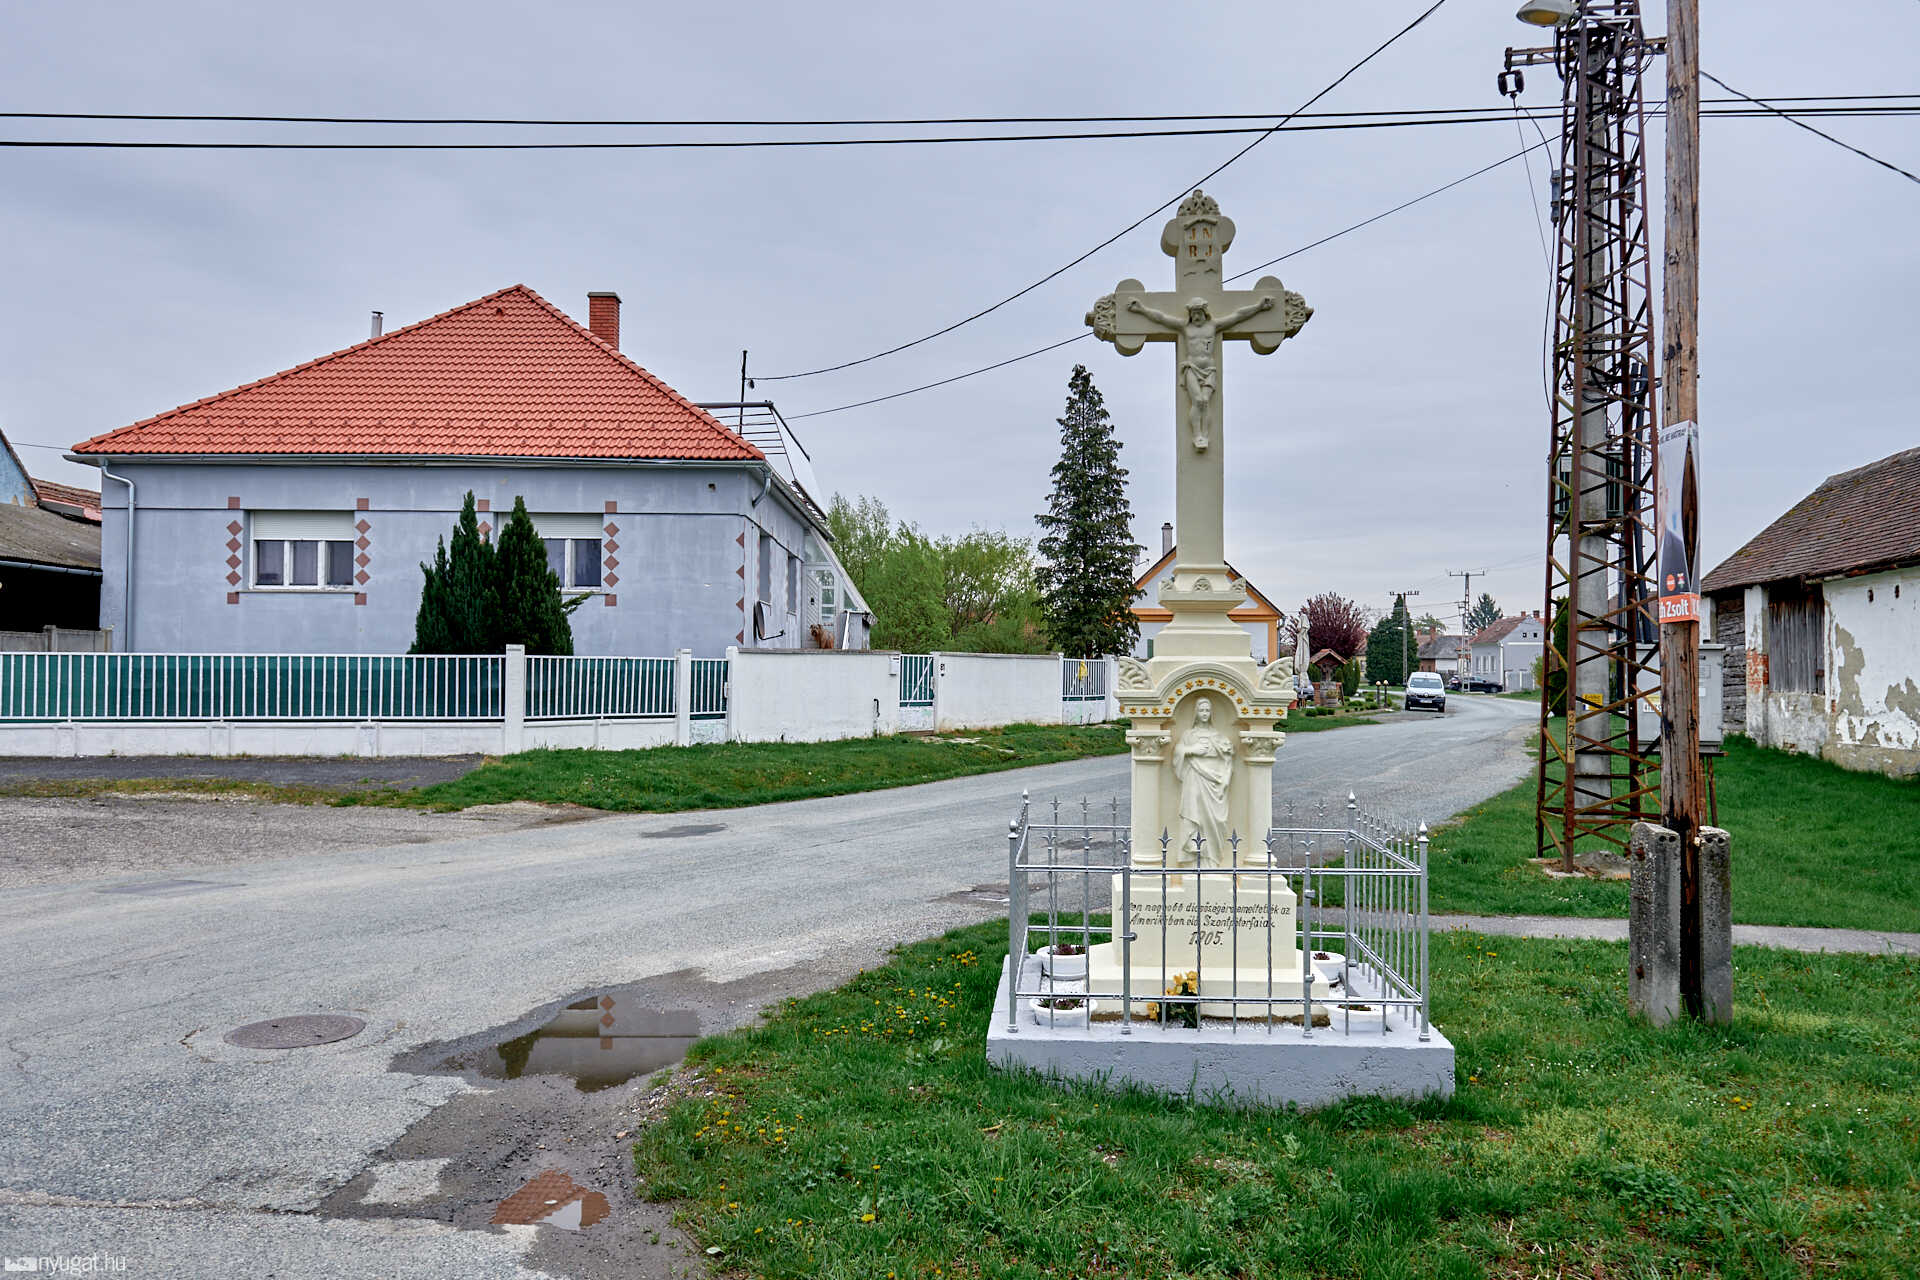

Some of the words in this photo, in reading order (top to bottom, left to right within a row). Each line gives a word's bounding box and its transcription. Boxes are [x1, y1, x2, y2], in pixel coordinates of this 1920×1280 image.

[1666, 599, 1689, 617] Zsolt
[1145, 903, 1183, 914] nagobb
[1280, 907, 1290, 915] az
